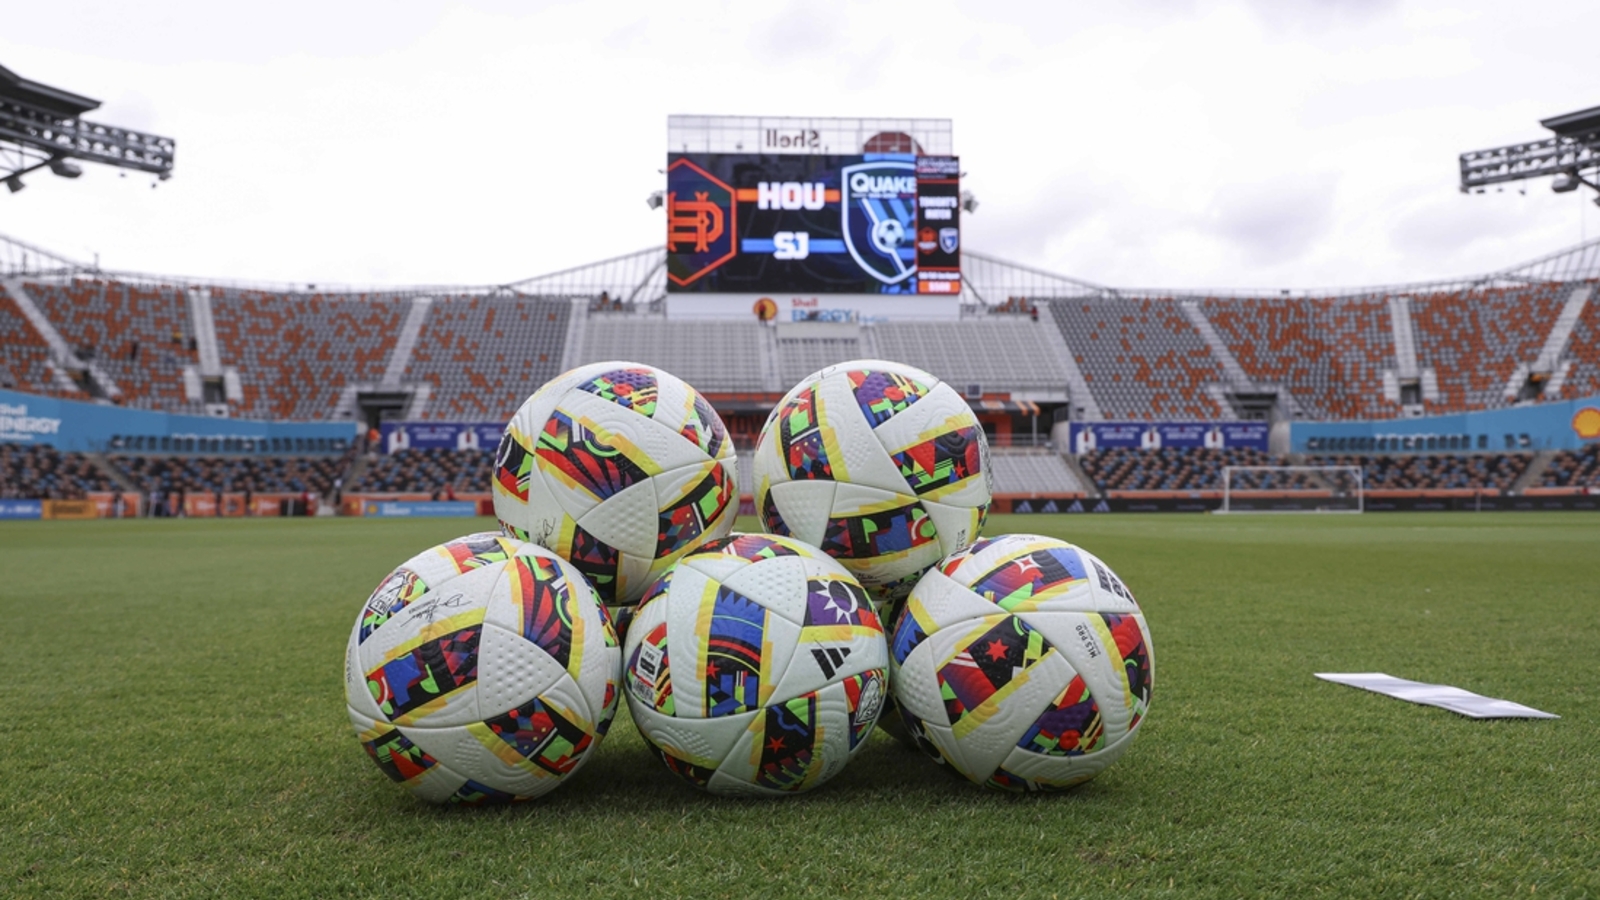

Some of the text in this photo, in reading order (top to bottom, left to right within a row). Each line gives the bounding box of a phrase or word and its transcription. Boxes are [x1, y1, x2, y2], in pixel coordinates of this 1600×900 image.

[757, 182, 826, 210] HOU
[773, 231, 810, 260] SJ
[1075, 624, 1089, 641] PRO
